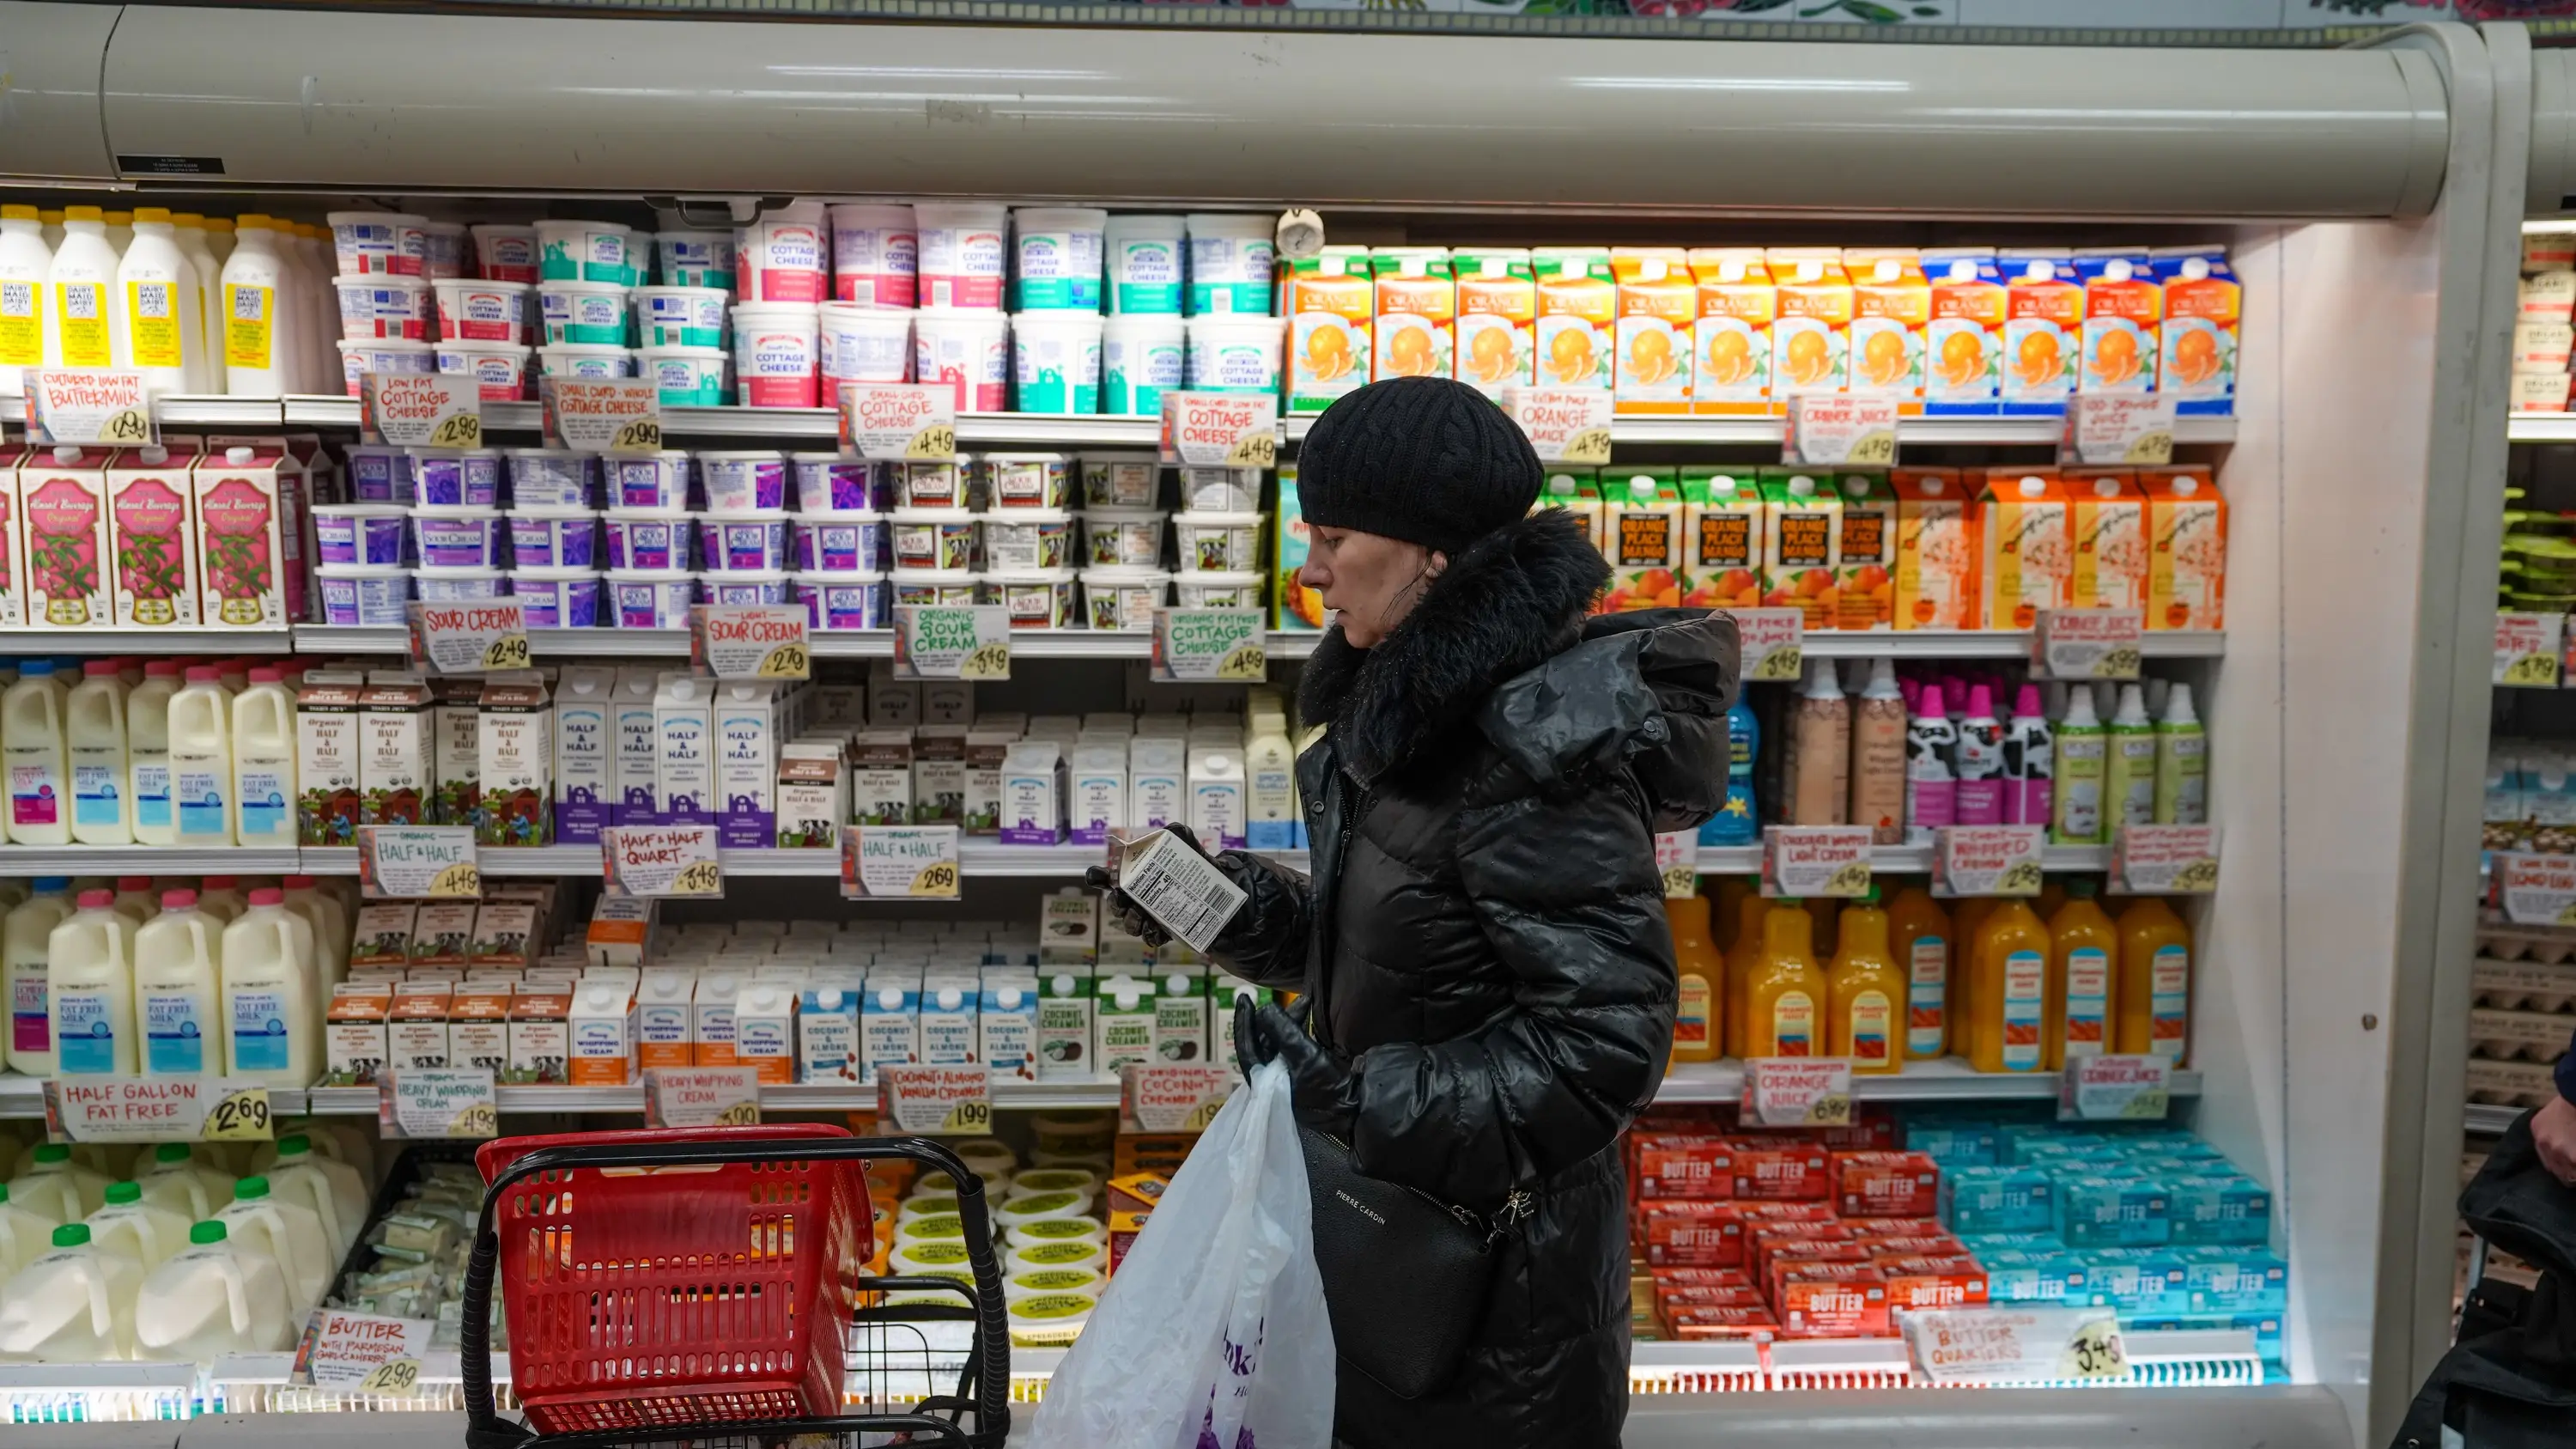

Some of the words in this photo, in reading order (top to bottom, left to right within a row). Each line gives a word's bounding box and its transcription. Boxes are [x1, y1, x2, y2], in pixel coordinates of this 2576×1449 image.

[756, 353, 805, 363] COTTAGE
[760, 363, 802, 373] CHEESE
[1219, 367, 1264, 375] COTTAGE
[99, 375, 118, 387] LOW
[122, 375, 141, 388] FAT
[387, 378, 410, 389] LOW
[414, 378, 433, 389] FAT
[1223, 376, 1261, 385] CHEESE
[48, 387, 140, 409] BUTTERMILK
[380, 390, 450, 405] COTTAGE
[560, 383, 586, 398] SMALL
[386, 405, 439, 419] CHEESE
[560, 398, 603, 414] COTTAGE
[605, 399, 647, 415] CHEESE
[860, 399, 933, 417] COTTAGE
[864, 414, 916, 429] CHEESE
[1188, 409, 1253, 428] COTTAGE
[1522, 406, 1592, 429] ORANGE
[1855, 408, 1890, 425] JUICE
[1183, 427, 1238, 445] CHEESE
[1529, 428, 1567, 444] JUICE
[1621, 520, 1668, 533] ORANGE
[448, 532, 481, 543] CREAM
[426, 608, 465, 632] SOUR
[468, 606, 521, 631] CREAM
[740, 612, 767, 620] LIGHT
[918, 609, 975, 622] ORGANIC
[709, 620, 750, 641] SOUR
[752, 621, 802, 642] CREAM
[919, 621, 975, 638] SOUR
[1171, 625, 1253, 642] COTTAGE
[914, 636, 977, 653] CREAM
[1175, 640, 1231, 655] CHEESE
[307, 718, 346, 728] Organic
[316, 729, 338, 738] HALF
[667, 732, 698, 740] HALF
[316, 747, 339, 756] HALF
[668, 751, 699, 759] HALF
[620, 832, 657, 849] HALF
[666, 831, 704, 847] HALF
[377, 842, 414, 863] HALF
[426, 844, 463, 864] HALF
[863, 842, 897, 858] HALF
[909, 842, 946, 858] HALF
[1128, 874, 1146, 892] Nutrition
[1143, 861, 1156, 874] Facts
[1145, 887, 1162, 904] Calories
[1163, 874, 1171, 884] 40
[59, 1005, 82, 1014] FAT
[83, 1005, 104, 1014] FREE
[60, 1014, 86, 1023] MILK
[1108, 1026, 1147, 1036] COCONUT
[811, 1043, 848, 1051] ALMOND
[1106, 1036, 1150, 1045] CREAMER
[662, 1074, 692, 1089] HEAVY
[694, 1074, 744, 1088] WHIPPING
[943, 1072, 985, 1084] ALMOND
[1761, 1075, 1831, 1090] ORANGE
[66, 1084, 115, 1103] HALF
[124, 1083, 197, 1101] GALLON
[398, 1084, 433, 1098] HEAVY
[435, 1084, 487, 1099] WHIPPING
[677, 1091, 717, 1105] CREAM
[416, 1098, 449, 1110] CREAM
[1766, 1092, 1812, 1107] JUICE
[87, 1105, 118, 1120] FAT
[125, 1103, 178, 1120] FREE
[1662, 1162, 1712, 1178] BUTTER
[1865, 1178, 1916, 1196] BUTTER
[1335, 1190, 1359, 1209] PIERRE
[1359, 1205, 1386, 1226] CARDIN
[2013, 1282, 2065, 1300] BUTTER
[2112, 1276, 2165, 1295] BUTTER
[1810, 1294, 1865, 1312] BUTTER
[1911, 1288, 1965, 1306] BUTTER
[328, 1317, 405, 1341] BUTTER
[1937, 1326, 2015, 1347] BUTTER
[321, 1340, 343, 1350] WITH
[345, 1341, 404, 1355] PARMESAN
[1932, 1346, 2022, 1365] QUARTERS
[375, 1362, 417, 1390] 2.99
